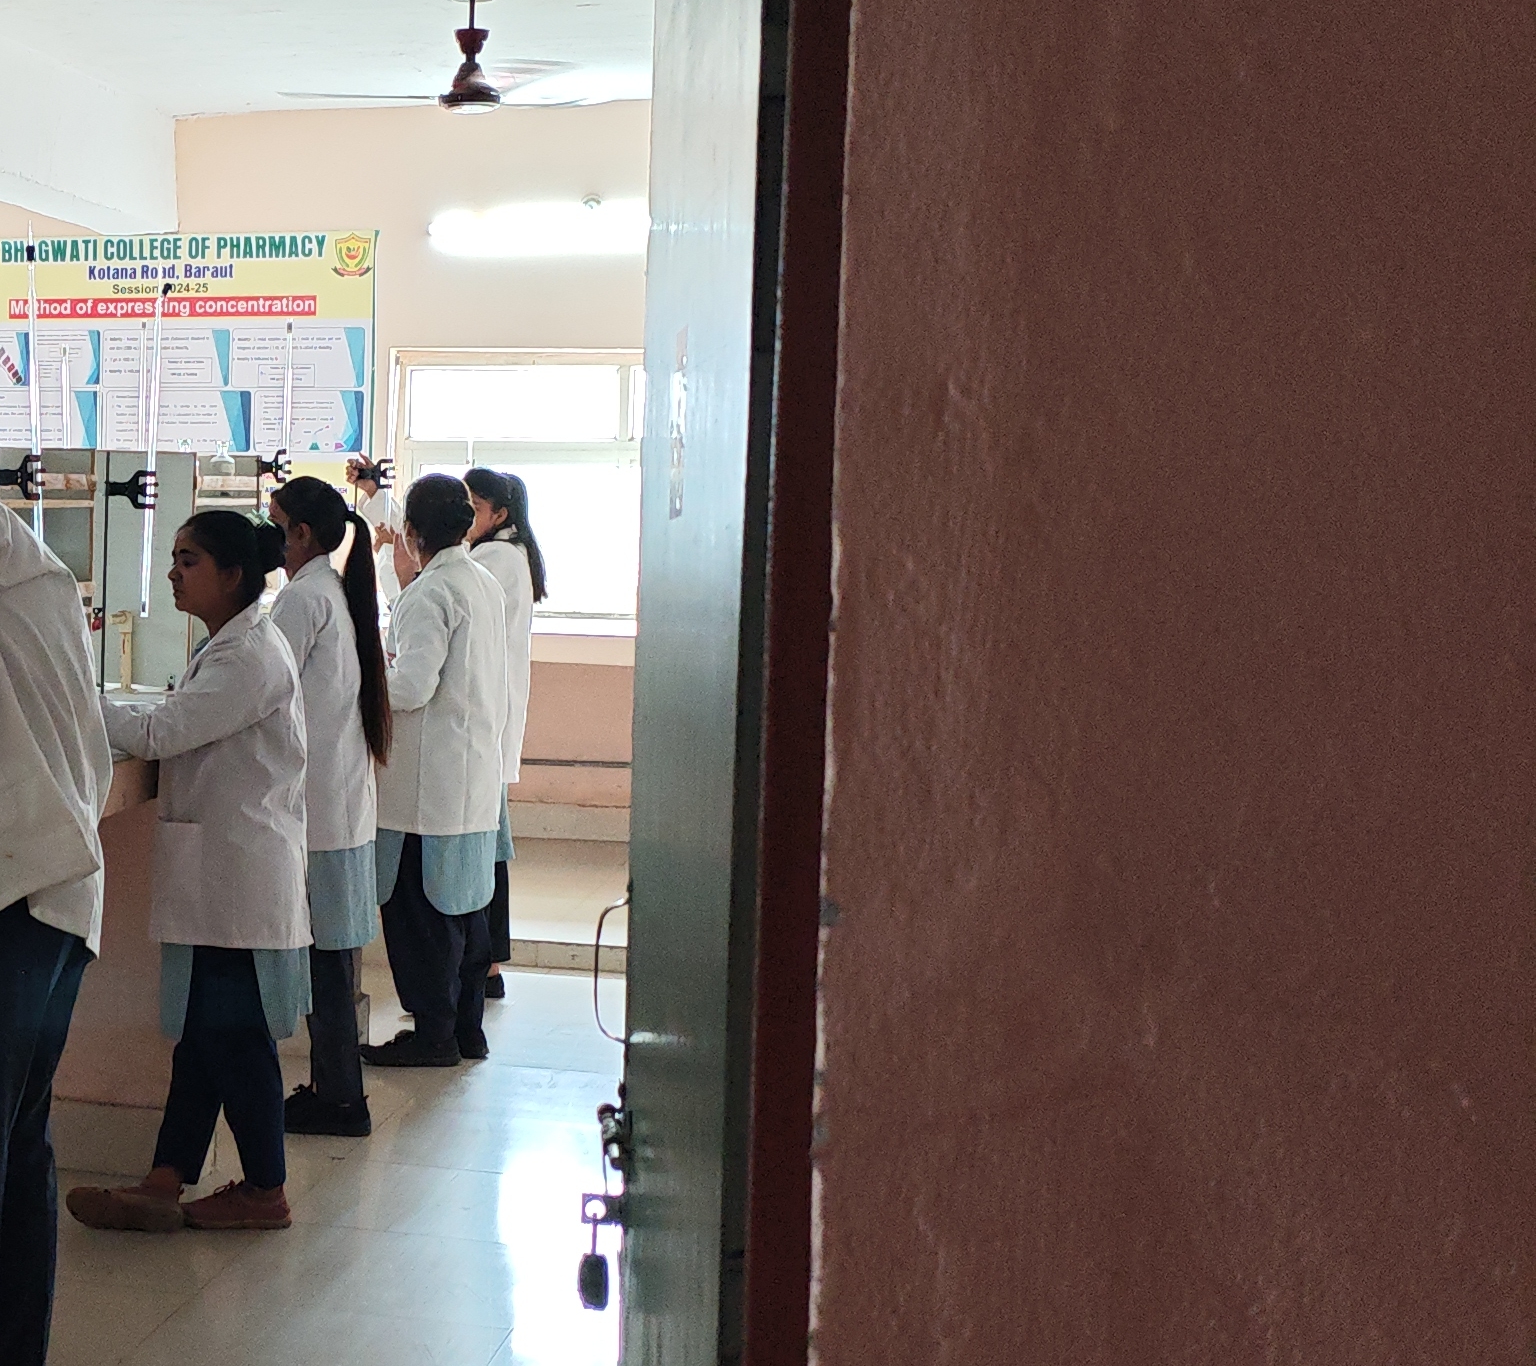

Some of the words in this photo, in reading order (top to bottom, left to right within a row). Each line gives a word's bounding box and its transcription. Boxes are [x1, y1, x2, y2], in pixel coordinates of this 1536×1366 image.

[1, 238, 97, 263] BHGWATI
[103, 237, 182, 262] COLLEGE
[188, 236, 211, 260] OF
[216, 234, 327, 260] PHARMACY
[88, 265, 137, 281] Kotana
[183, 263, 234, 280] Baraut
[112, 283, 159, 295] Session
[163, 283, 209, 294] 024-25
[75, 299, 94, 315] of
[195, 296, 315, 314] concentration
